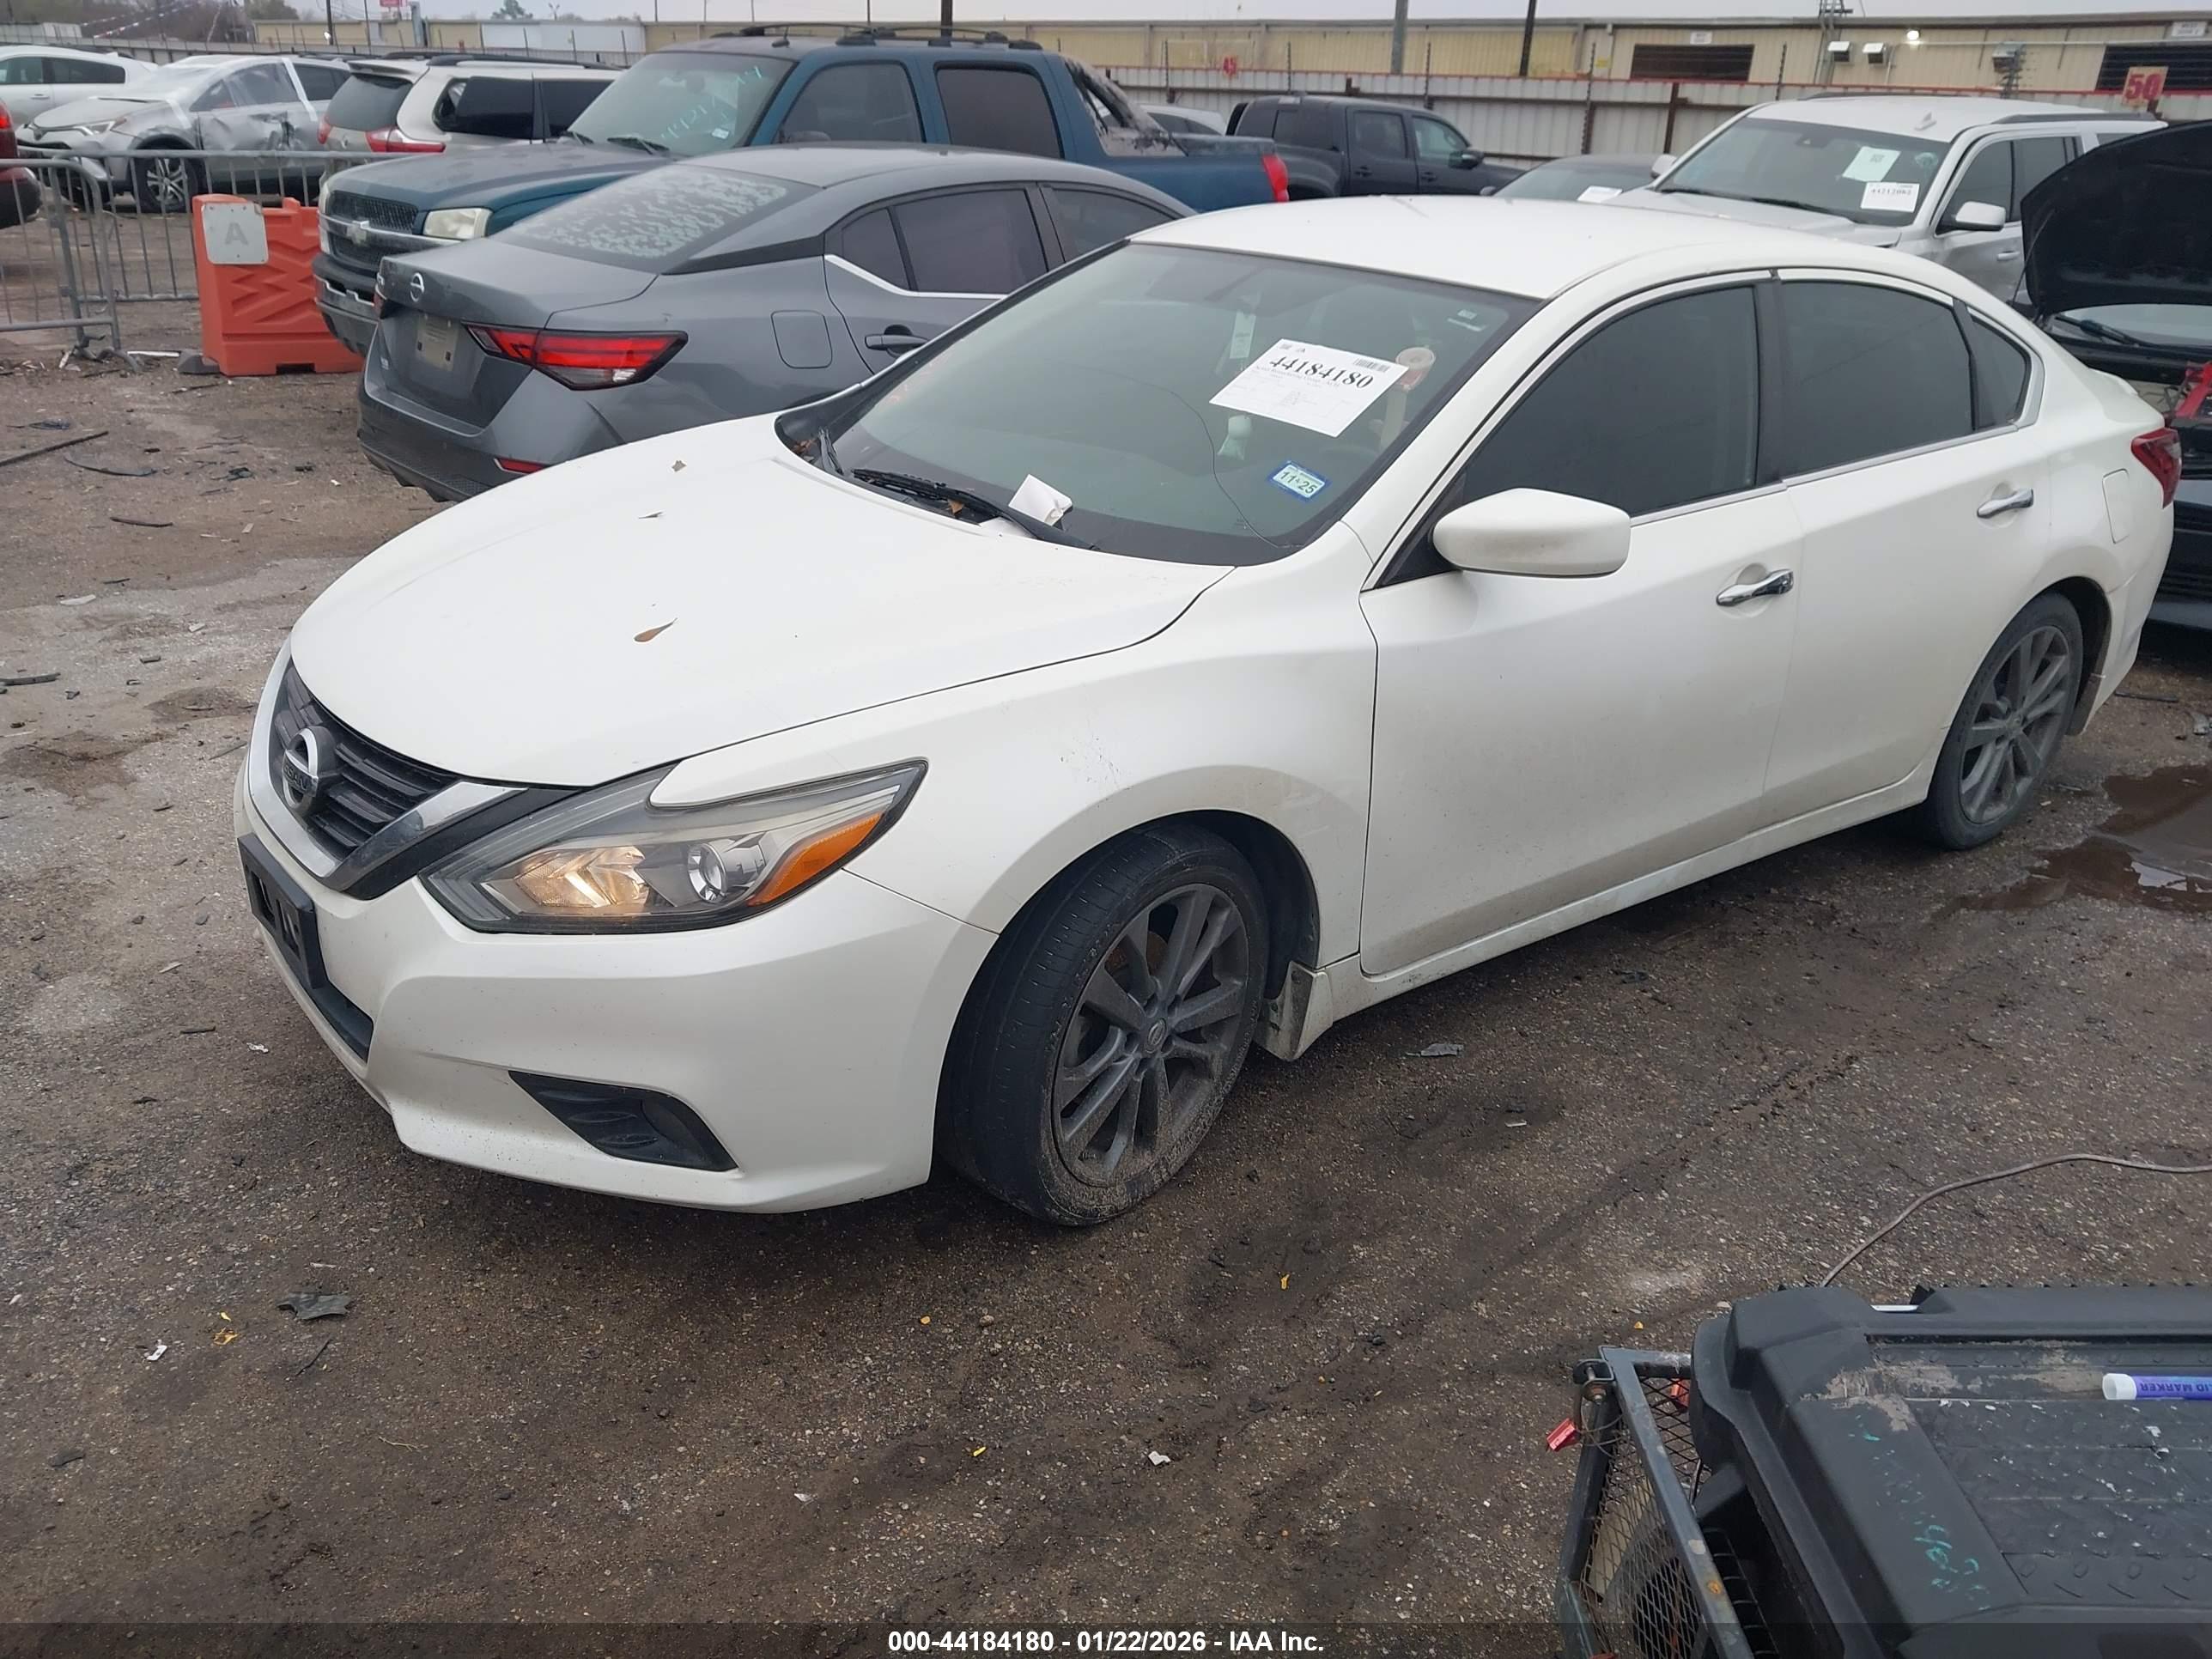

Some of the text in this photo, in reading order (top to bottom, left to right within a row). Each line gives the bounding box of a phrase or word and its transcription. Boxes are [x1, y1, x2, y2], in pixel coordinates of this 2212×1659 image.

[2125, 74, 2162, 100] 50
[225, 222, 249, 246] A
[1268, 356, 1375, 390] 44184180
[1297, 481, 1318, 494] 25
[2140, 1382, 2192, 1391] MARKER
